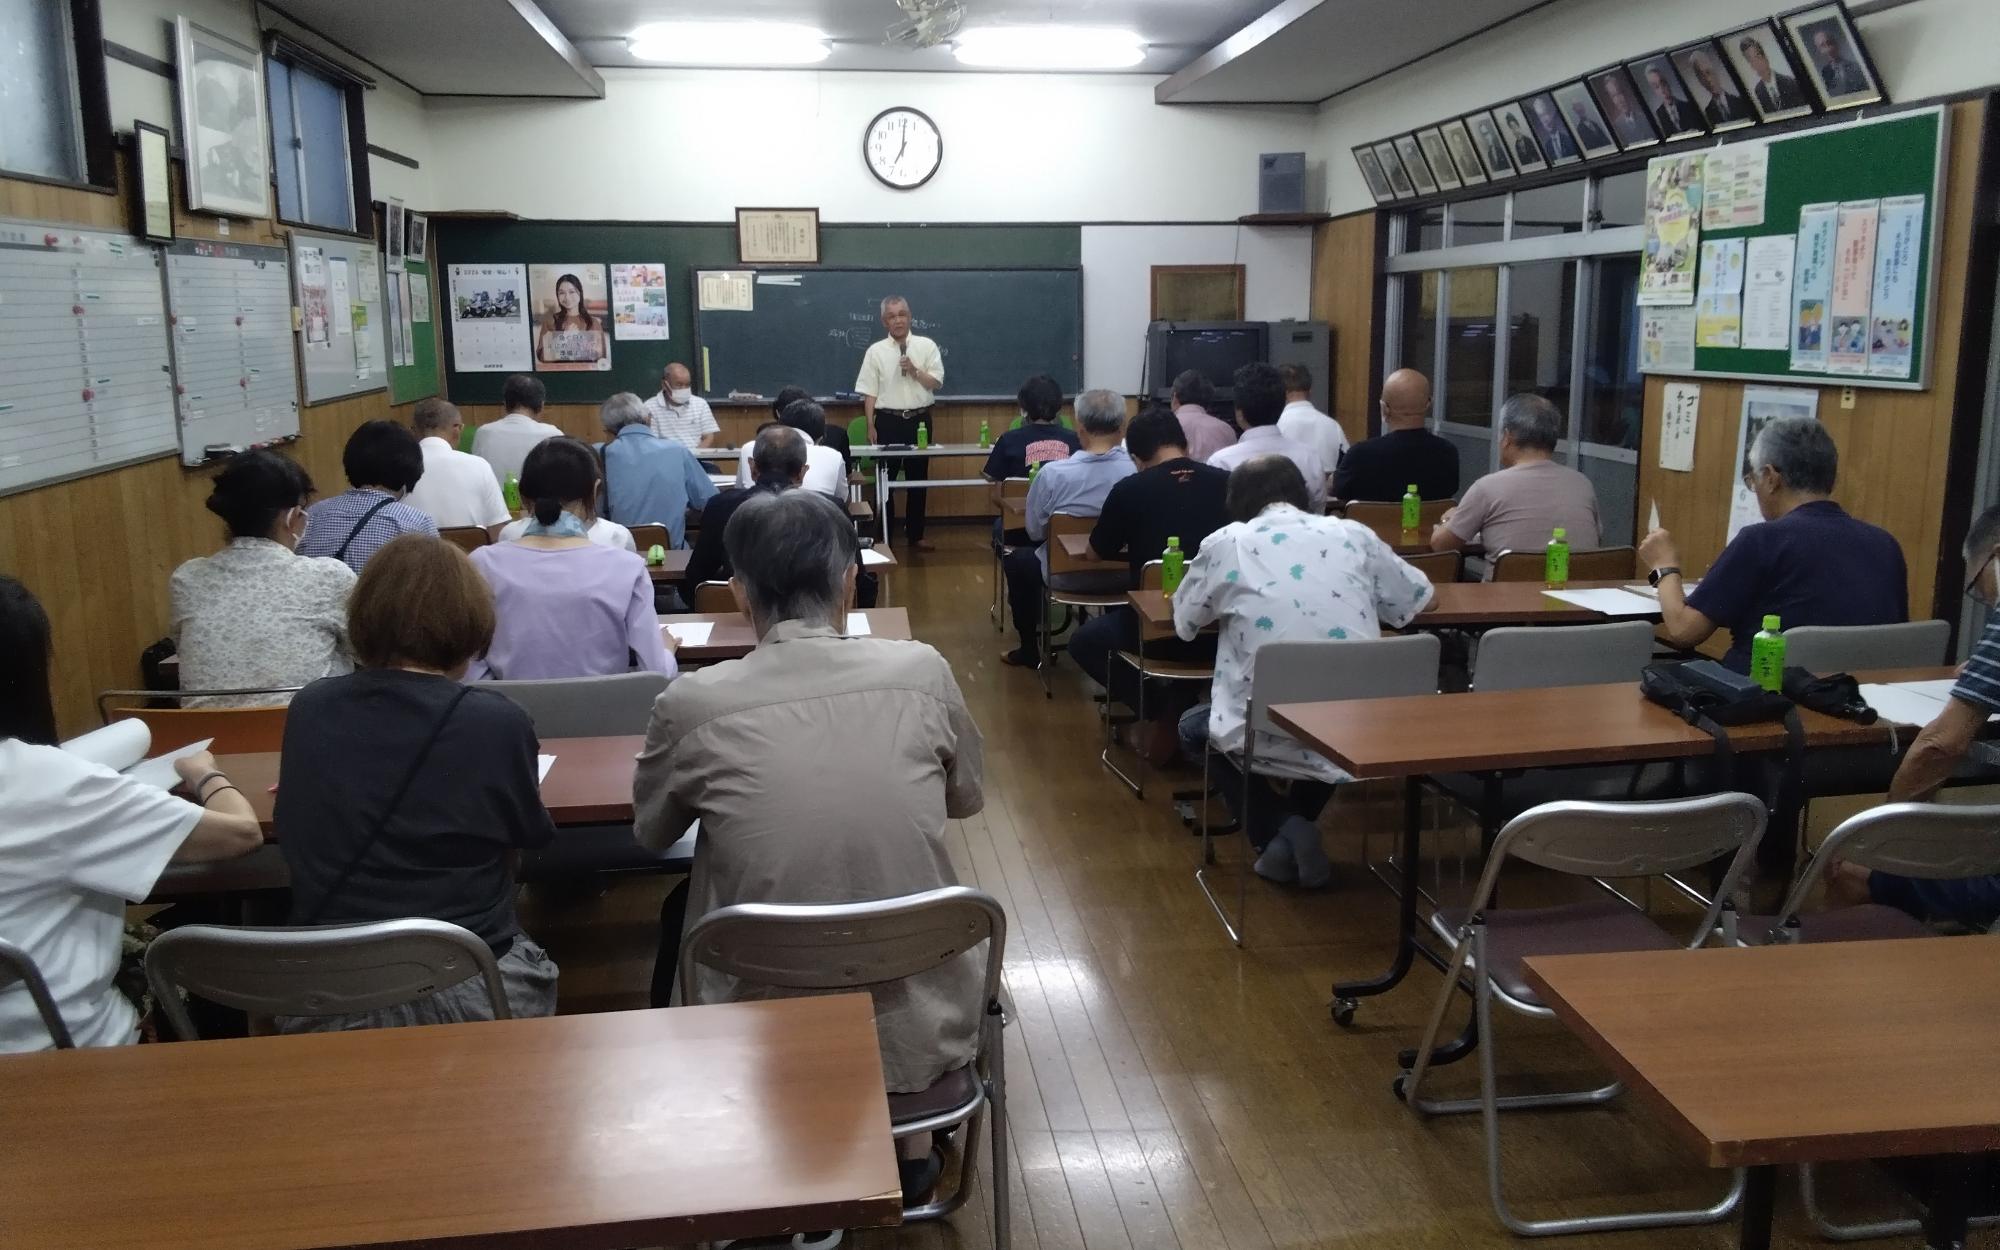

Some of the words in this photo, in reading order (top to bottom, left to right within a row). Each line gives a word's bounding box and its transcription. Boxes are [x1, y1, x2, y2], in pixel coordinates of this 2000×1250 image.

[887, 121, 894, 131] 11
[878, 131, 887, 140] 10
[875, 143, 882, 153] 9
[879, 156, 886, 166] 8
[889, 165, 895, 176] 7
